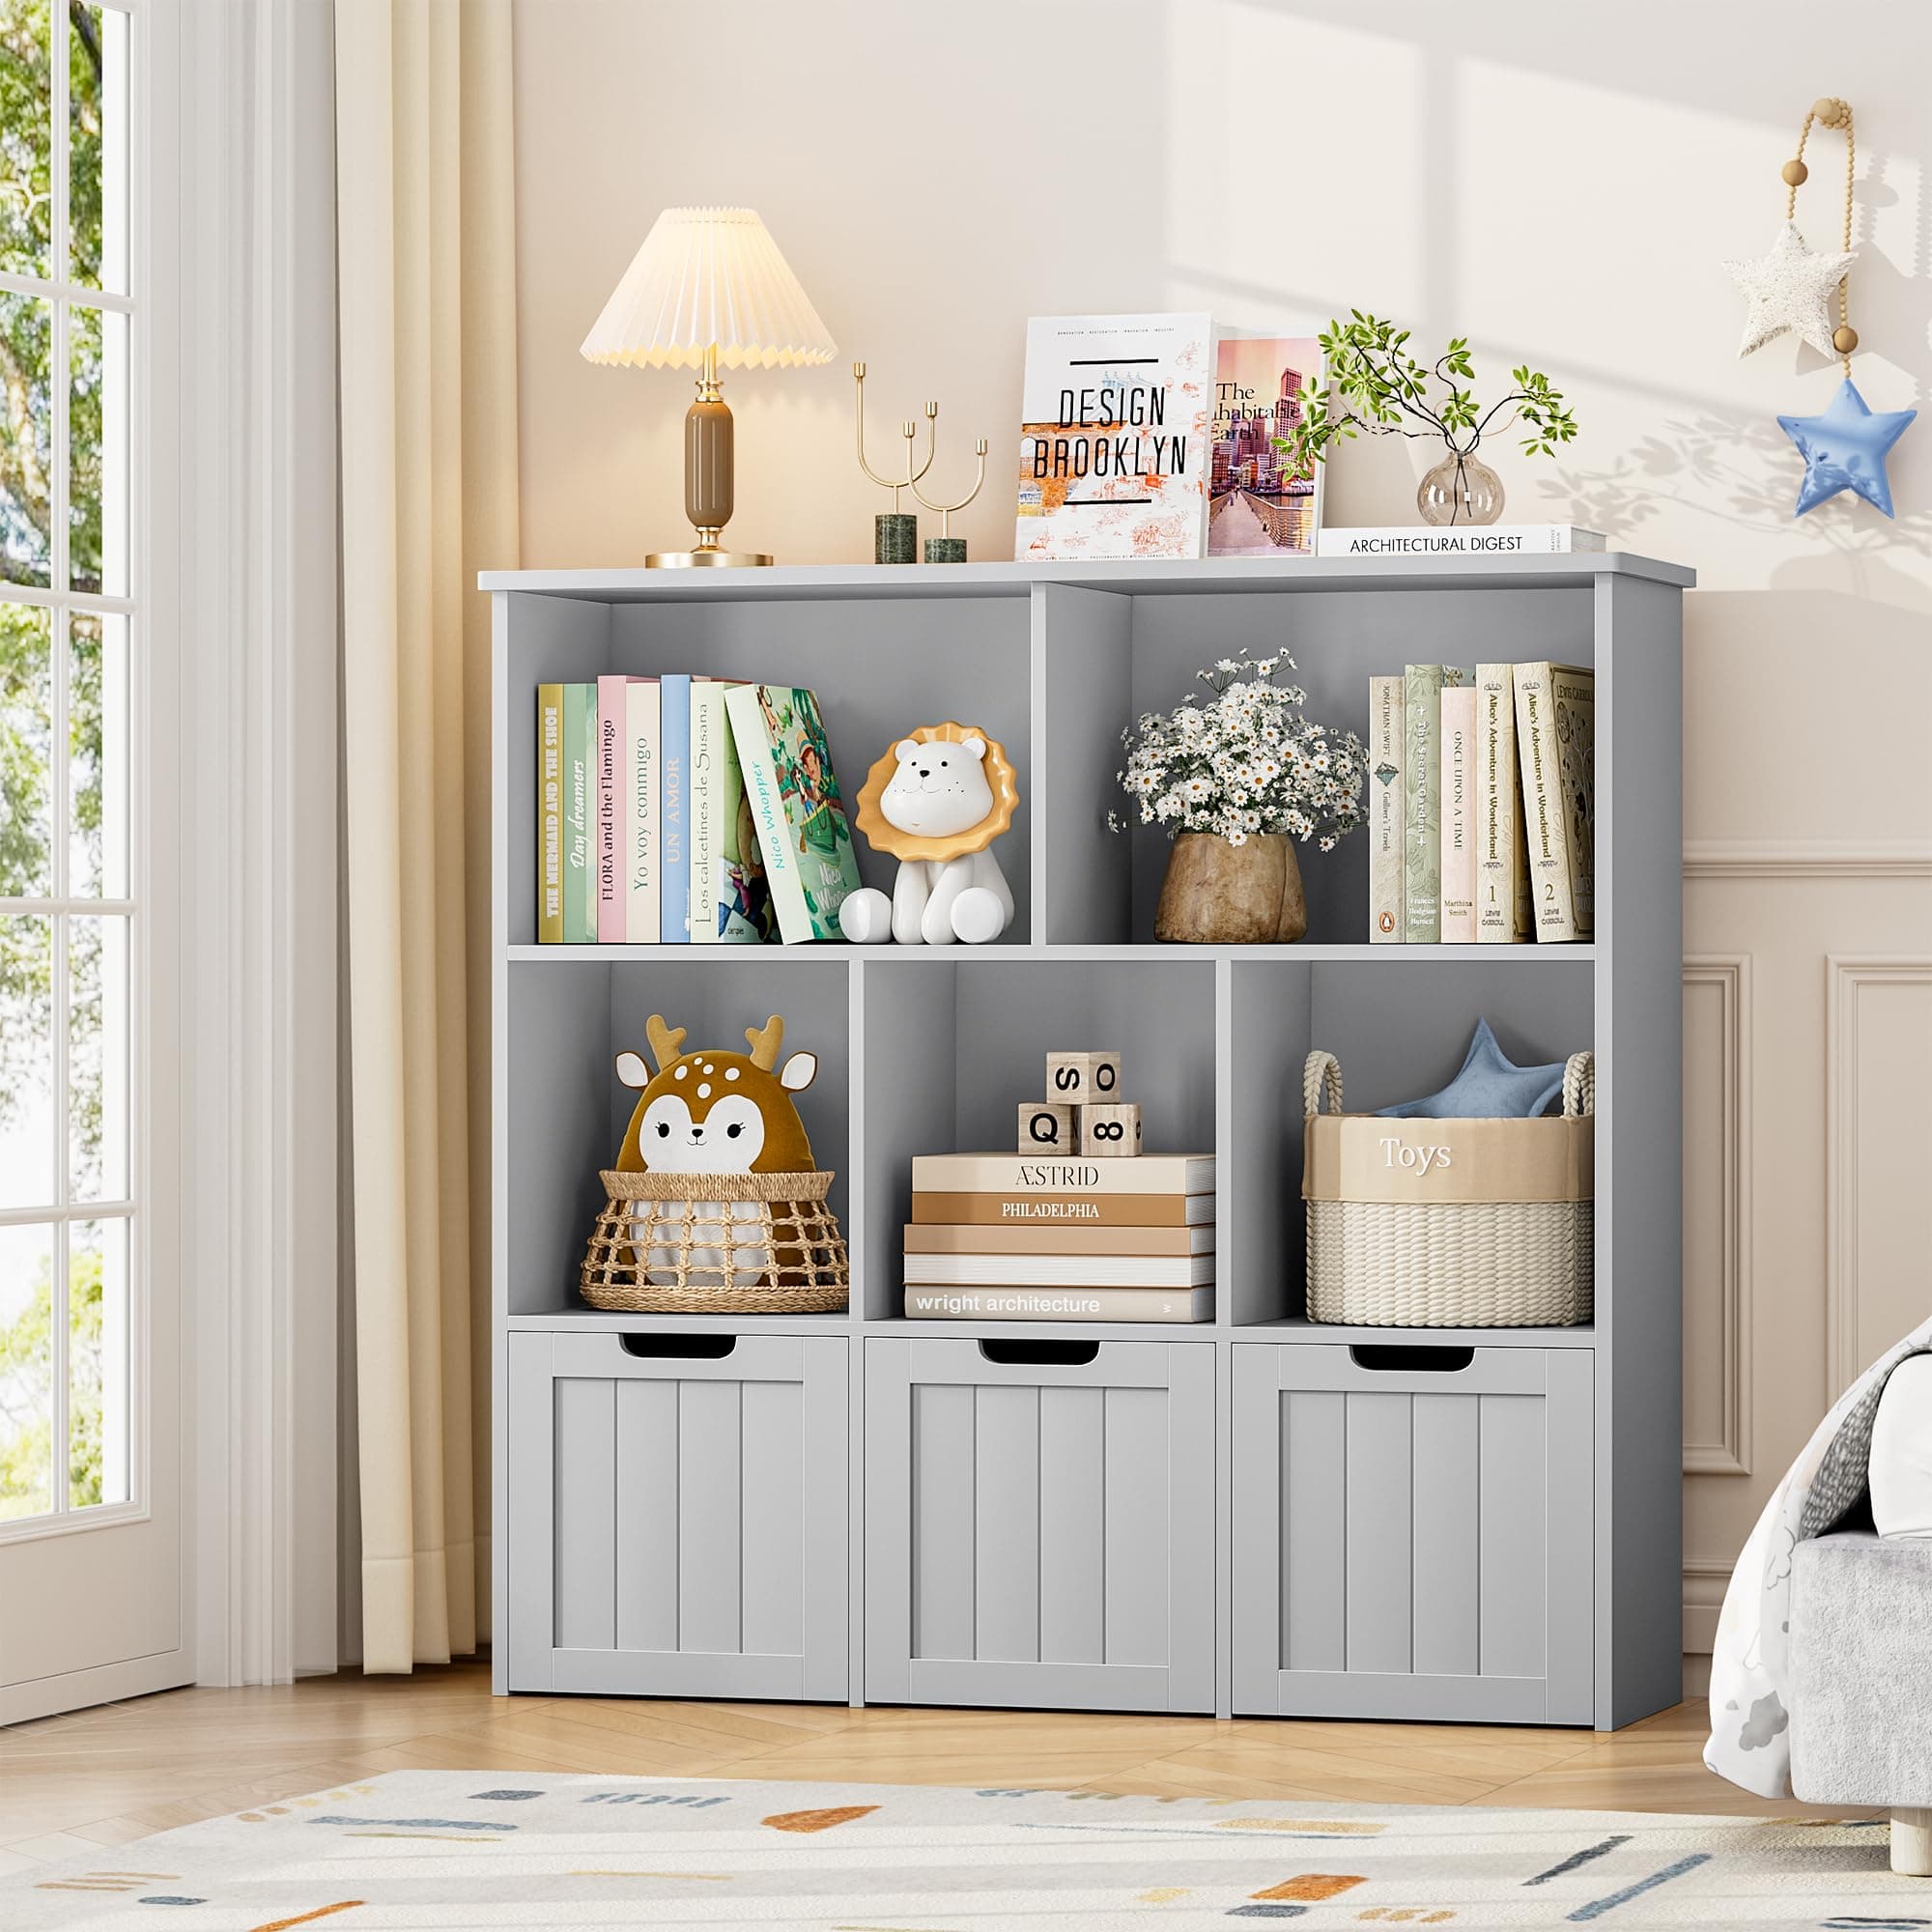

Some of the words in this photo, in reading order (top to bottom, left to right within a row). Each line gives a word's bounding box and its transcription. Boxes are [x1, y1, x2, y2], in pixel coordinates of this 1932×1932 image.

[1216, 382, 1255, 400] The
[1059, 386, 1165, 429] DESIGN
[1213, 403, 1300, 420] habitable
[1034, 436, 1186, 478] BROOKLYN
[1350, 538, 1466, 553] ARCHITECTURAL
[1470, 536, 1522, 551] DIGEST
[1382, 684, 1391, 728] JONATHAN
[1528, 694, 1539, 724] Alice's
[545, 706, 557, 746] SHOE
[695, 704, 710, 771] Susana
[601, 720, 615, 788] Flamingo
[1454, 731, 1463, 765] ONCE
[1531, 726, 1543, 781] Adventure
[545, 749, 557, 779] THE
[636, 738, 651, 818] conmigo
[546, 781, 557, 811] AND
[567, 759, 584, 831] dreamers
[666, 757, 680, 825] AMOR
[695, 777, 708, 797] de
[752, 761, 775, 830] Whopper
[1454, 769, 1463, 804] UPON
[601, 793, 612, 817] the
[1382, 792, 1391, 824] Gulliver's
[601, 822, 613, 850] and
[638, 826, 652, 858] voy
[1382, 827, 1391, 851] Travels
[1454, 820, 1463, 850] TIME
[1538, 795, 1551, 858] Wonderland
[570, 835, 592, 868] Day
[668, 834, 681, 864] UN
[771, 837, 784, 868] Nico
[602, 853, 613, 900] FLORA
[634, 867, 649, 891] Yo
[1545, 884, 1554, 900] 2
[546, 888, 558, 918] THE
[696, 889, 711, 923] Los
[1489, 885, 1496, 902] 1
[1055, 1066, 1080, 1091] S
[1030, 1113, 1059, 1145] Q
[1094, 1122, 1123, 1141] 8
[1379, 1138, 1452, 1177] Toys
[1015, 1166, 1099, 1186] ÆSTRID
[1001, 1203, 1100, 1218] PHILADELPHIA
[916, 1294, 980, 1314] wright
[986, 1294, 1100, 1313] architecture
